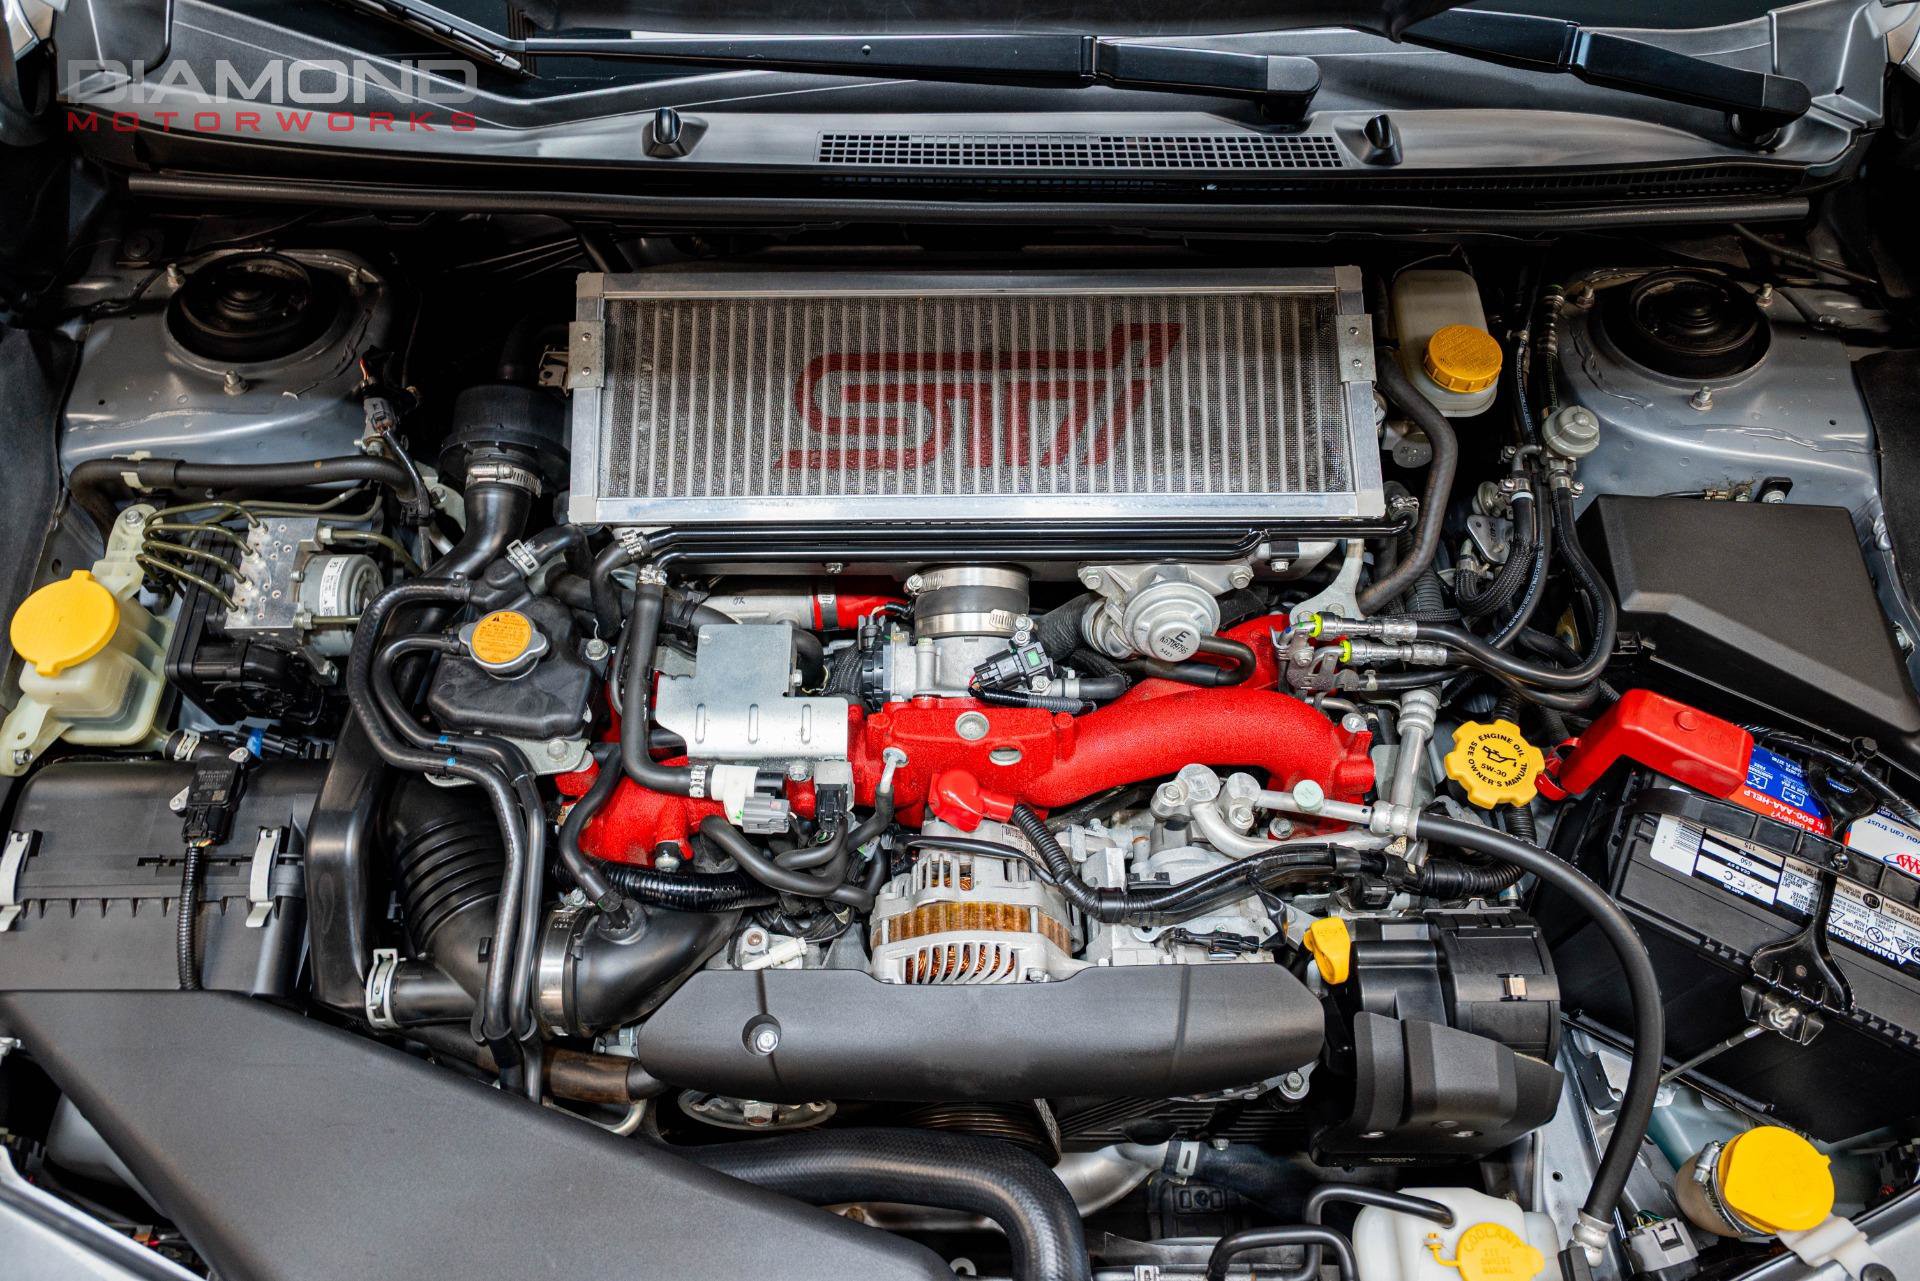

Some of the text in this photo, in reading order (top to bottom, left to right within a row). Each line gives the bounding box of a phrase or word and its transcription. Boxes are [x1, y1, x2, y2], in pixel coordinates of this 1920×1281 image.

[1478, 733, 1526, 758] ENGINE OIL
[1467, 740, 1528, 788] SEE OWNER'S MANUAL
[1480, 762, 1507, 778] 5W-30
[1743, 790, 1815, 824] 800-AAA-HELP
[1867, 820, 1887, 831] trust
[1889, 827, 1904, 838] can
[1739, 857, 1753, 867] 650
[1731, 886, 1744, 895] PART
[1826, 925, 1896, 960] DANGER/POIS
[1464, 1227, 1522, 1252] COOLANT
